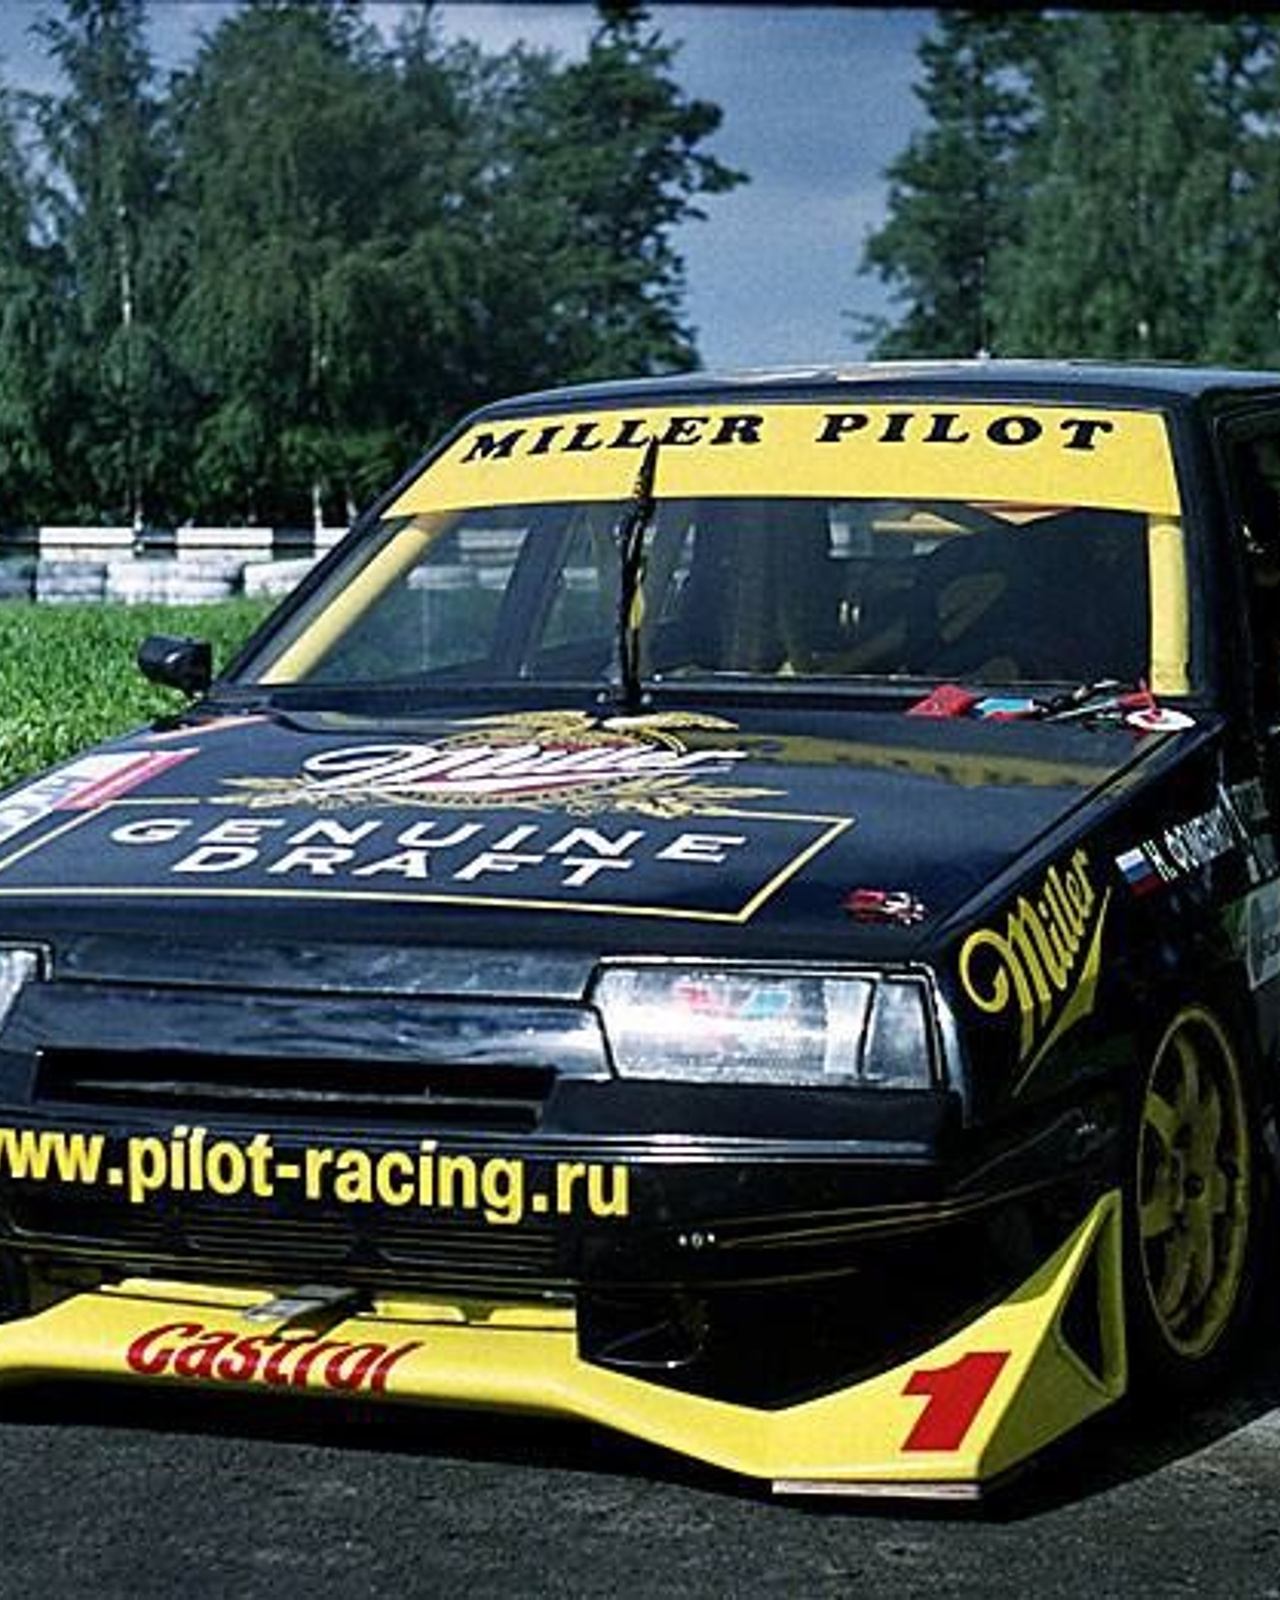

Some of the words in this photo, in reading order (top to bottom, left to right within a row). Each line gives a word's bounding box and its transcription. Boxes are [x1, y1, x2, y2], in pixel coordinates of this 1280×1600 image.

[460, 414, 763, 464] MILLER
[816, 412, 1115, 452] PILOT
[110, 818, 747, 863] GENUINE
[171, 845, 634, 887] DRAFT
[958, 847, 1096, 1060] Miller
[0, 1124, 629, 1224] ww.pilot-racing.ru
[126, 1322, 425, 1392] Castrol
[900, 1351, 1012, 1451] 1
